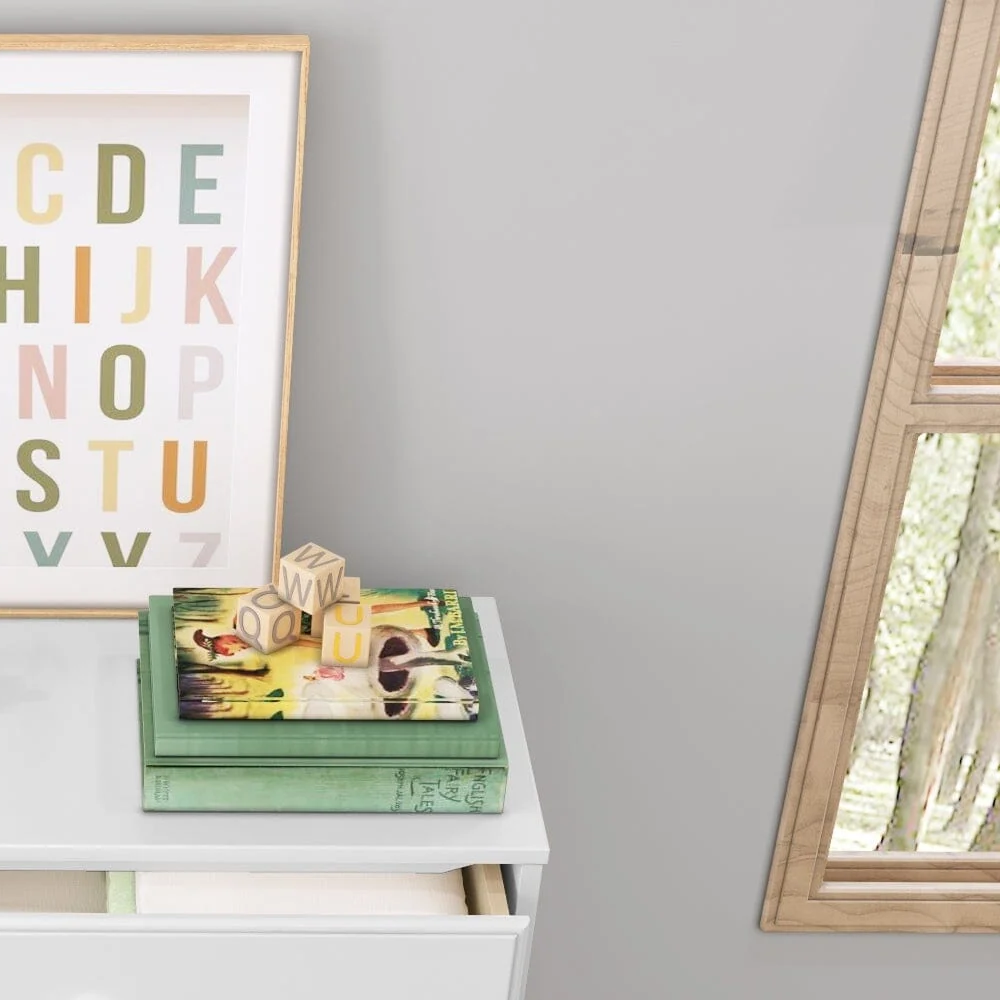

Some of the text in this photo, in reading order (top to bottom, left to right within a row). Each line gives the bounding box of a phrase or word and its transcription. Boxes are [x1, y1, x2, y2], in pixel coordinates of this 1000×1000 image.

[15, 142, 65, 226] C
[96, 143, 146, 225] D
[178, 144, 224, 225] E
[74, 246, 91, 325] I
[120, 246, 153, 325] J
[184, 246, 237, 325] K
[18, 344, 68, 420] N
[100, 343, 147, 421] O
[178, 345, 225, 421] P
[16, 439, 61, 513] S
[88, 440, 134, 512] T
[161, 440, 208, 514] U
[294, 545, 341, 569] W
[282, 565, 313, 607] W
[317, 566, 344, 608] W
[239, 605, 263, 649] Q
[272, 610, 298, 644] Q
[333, 631, 362, 664] U
[414, 779, 440, 813] TALES
[465, 767, 492, 813] ENGLISH
